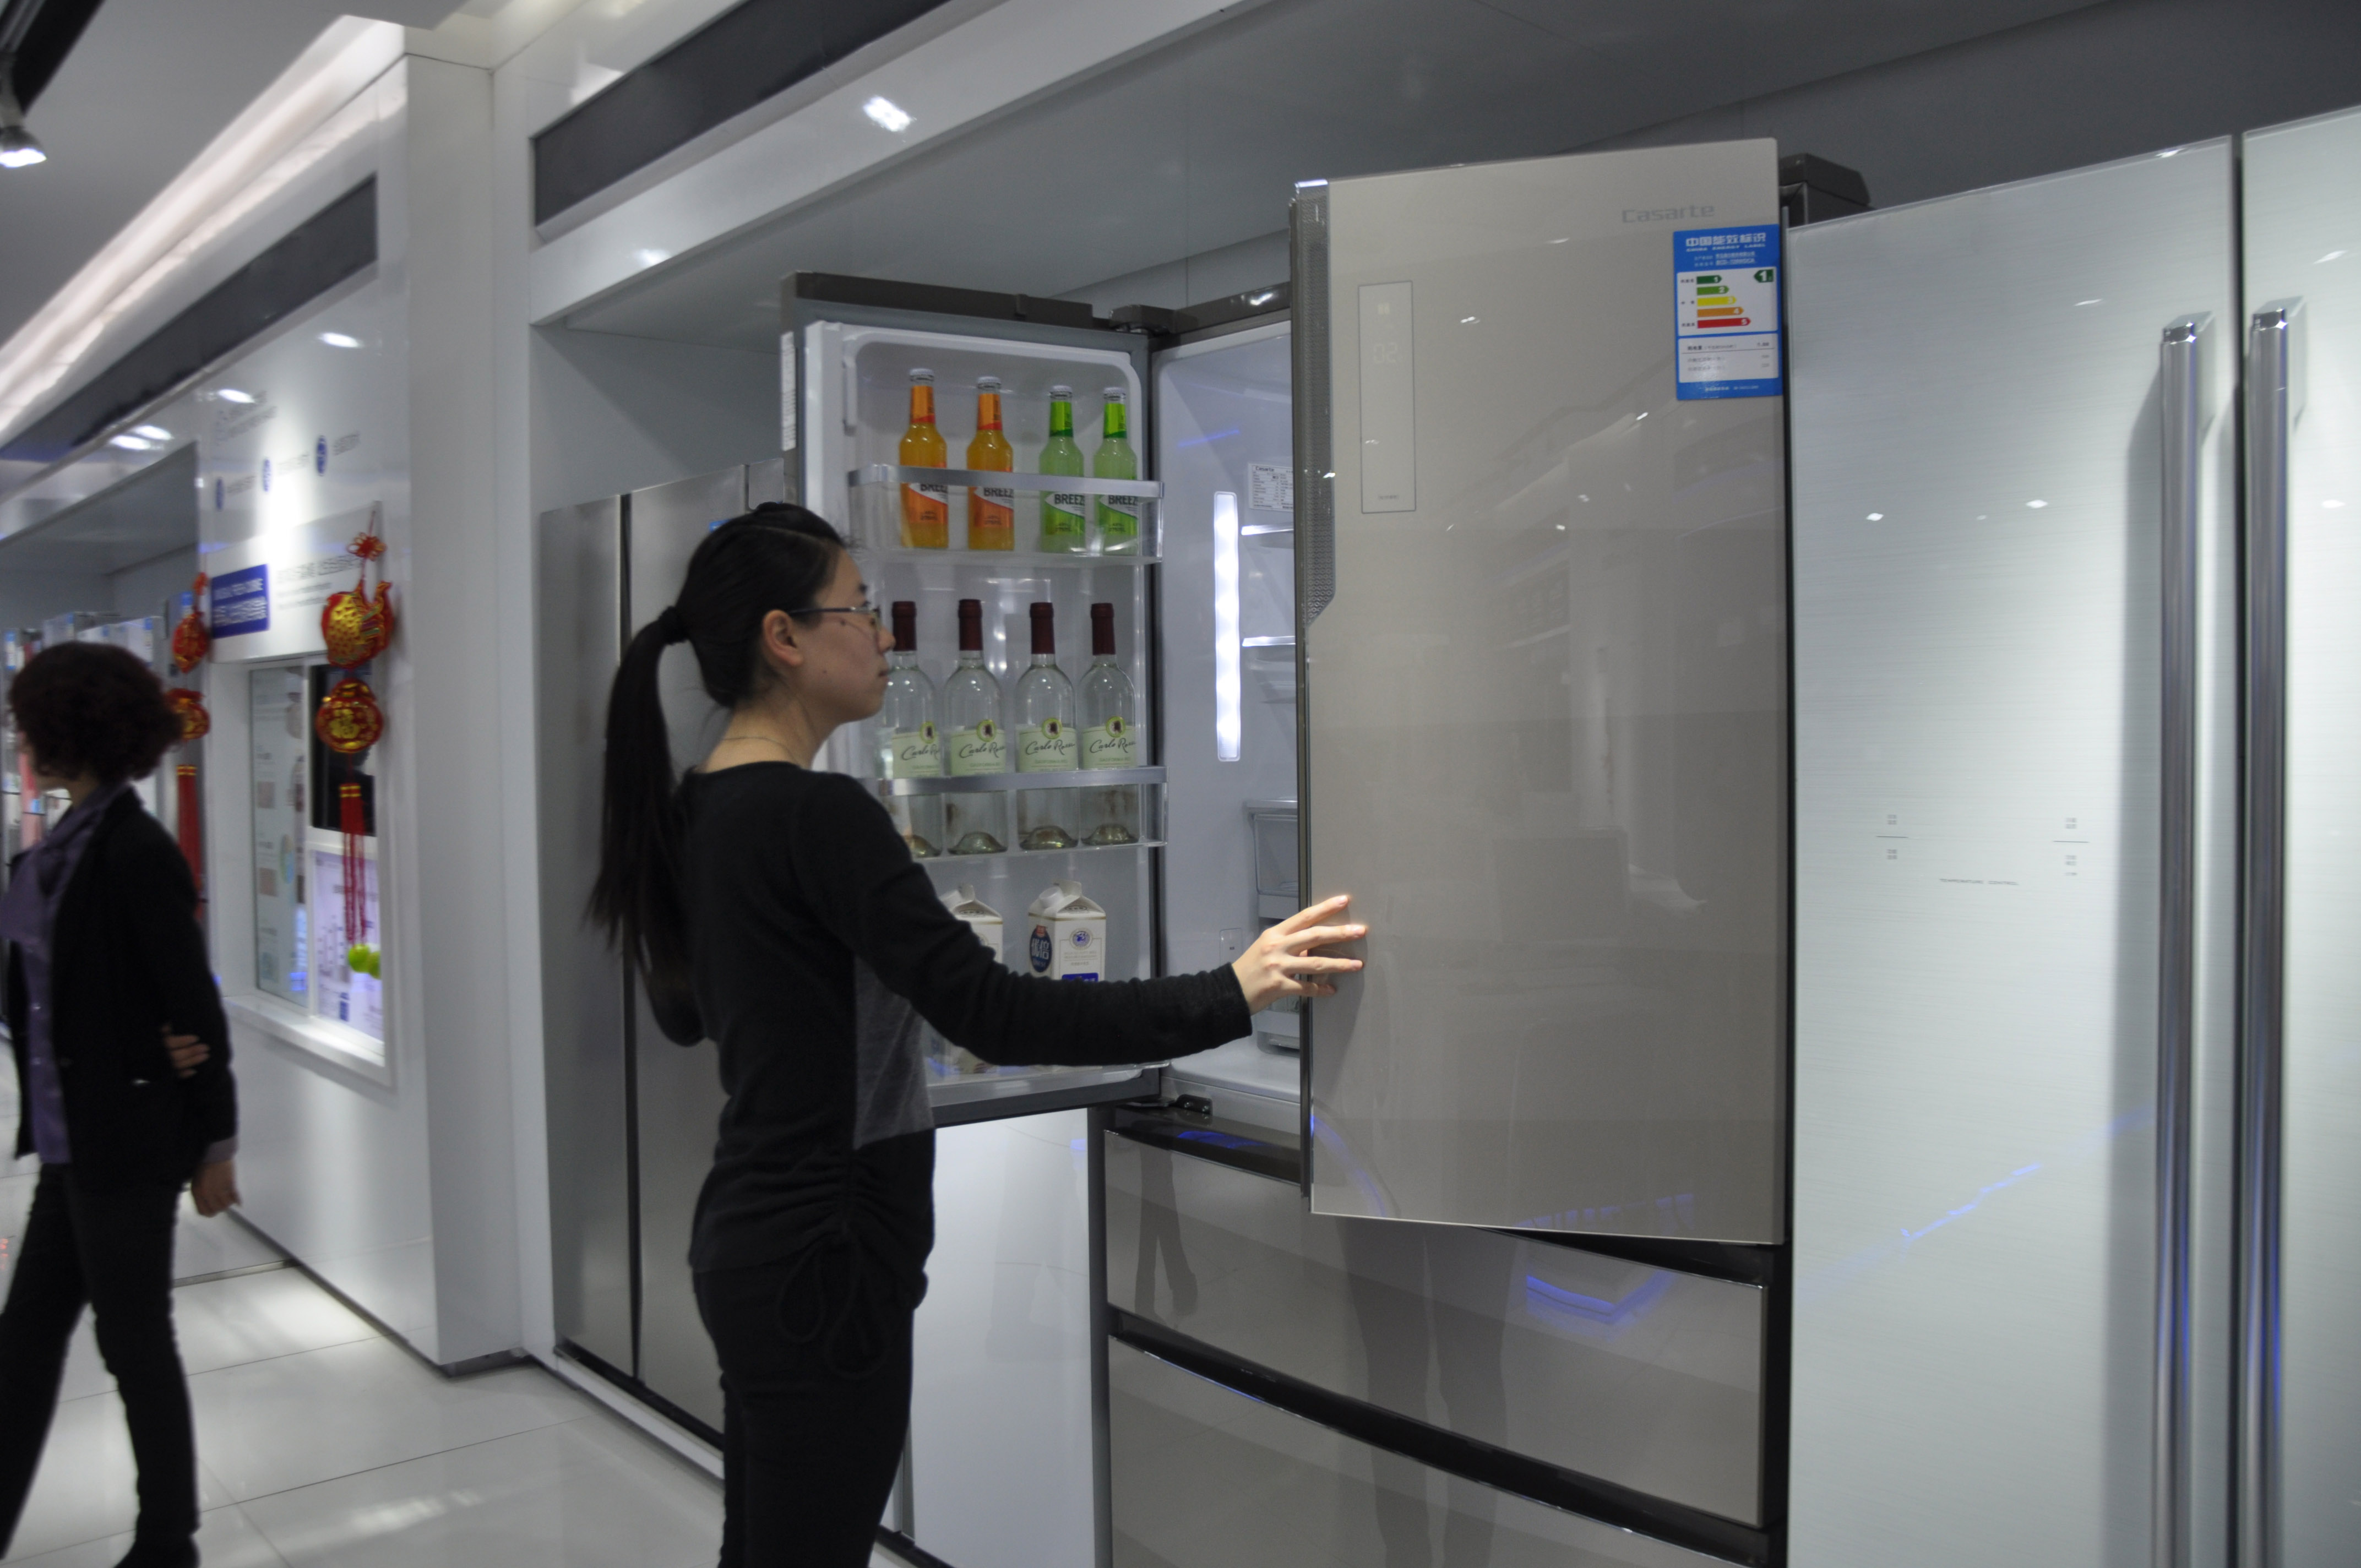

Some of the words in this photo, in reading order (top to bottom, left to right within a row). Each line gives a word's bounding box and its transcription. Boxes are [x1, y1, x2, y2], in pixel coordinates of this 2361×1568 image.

[1622, 204, 1715, 223] Casarte
[1685, 232, 1766, 247] 中国能效标识
[959, 742, 987, 759] Carlo
[1025, 739, 1052, 755] Carlo
[1089, 738, 1116, 754] Carlo
